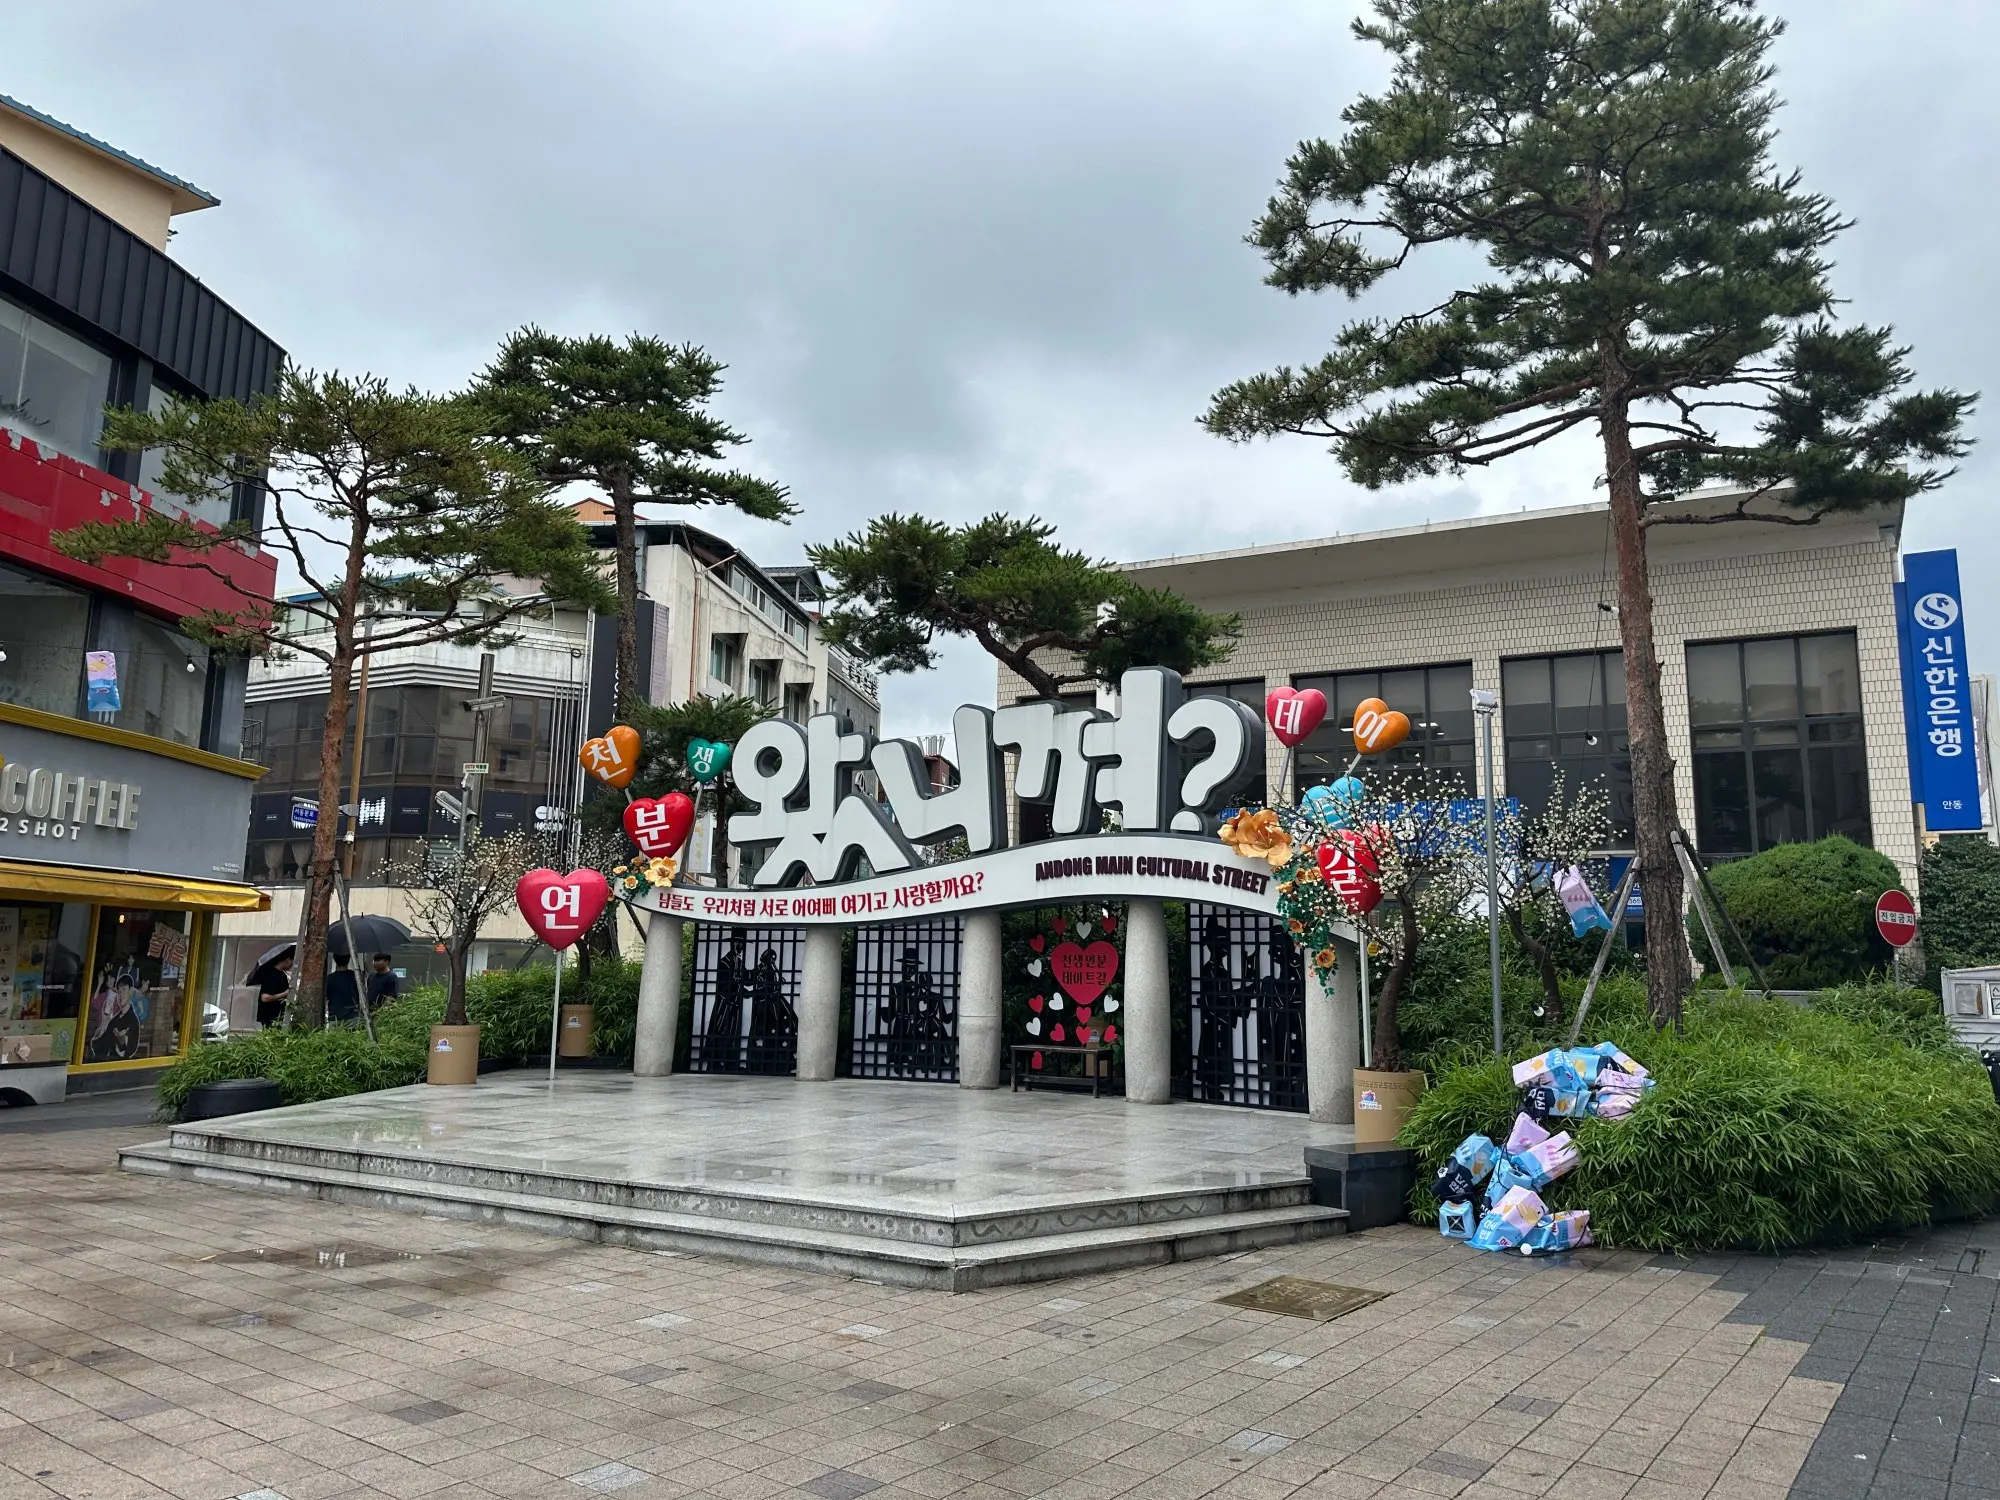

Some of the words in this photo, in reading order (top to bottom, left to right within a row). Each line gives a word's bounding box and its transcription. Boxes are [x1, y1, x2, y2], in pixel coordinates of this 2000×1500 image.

[1274, 698, 1304, 735] 데
[1921, 634, 1963, 757] 신한은행
[1355, 710, 1388, 749] 이
[586, 735, 628, 781] 천
[692, 746, 715, 774] 생
[728, 668, 1262, 887] 왔니껴?
[0, 762, 142, 831] COFFEE
[1942, 799, 1963, 810] 안동
[0, 817, 9, 832] 2
[18, 819, 81, 841] SHOT
[634, 803, 672, 852] 분
[658, 892, 695, 911] 남들도
[703, 896, 755, 917] 우리처럼
[760, 898, 788, 917] 서로
[792, 896, 836, 917] 어여삐
[841, 891, 888, 915] 여기고
[893, 871, 984, 908] 사랑할까요?
[1035, 857, 1093, 881] ANDONG
[1095, 856, 1133, 875] MAIN
[1136, 856, 1209, 882] CULTURAL
[1212, 864, 1270, 895] STREET
[540, 885, 581, 930] 연
[1880, 912, 1914, 924] 진입금지
